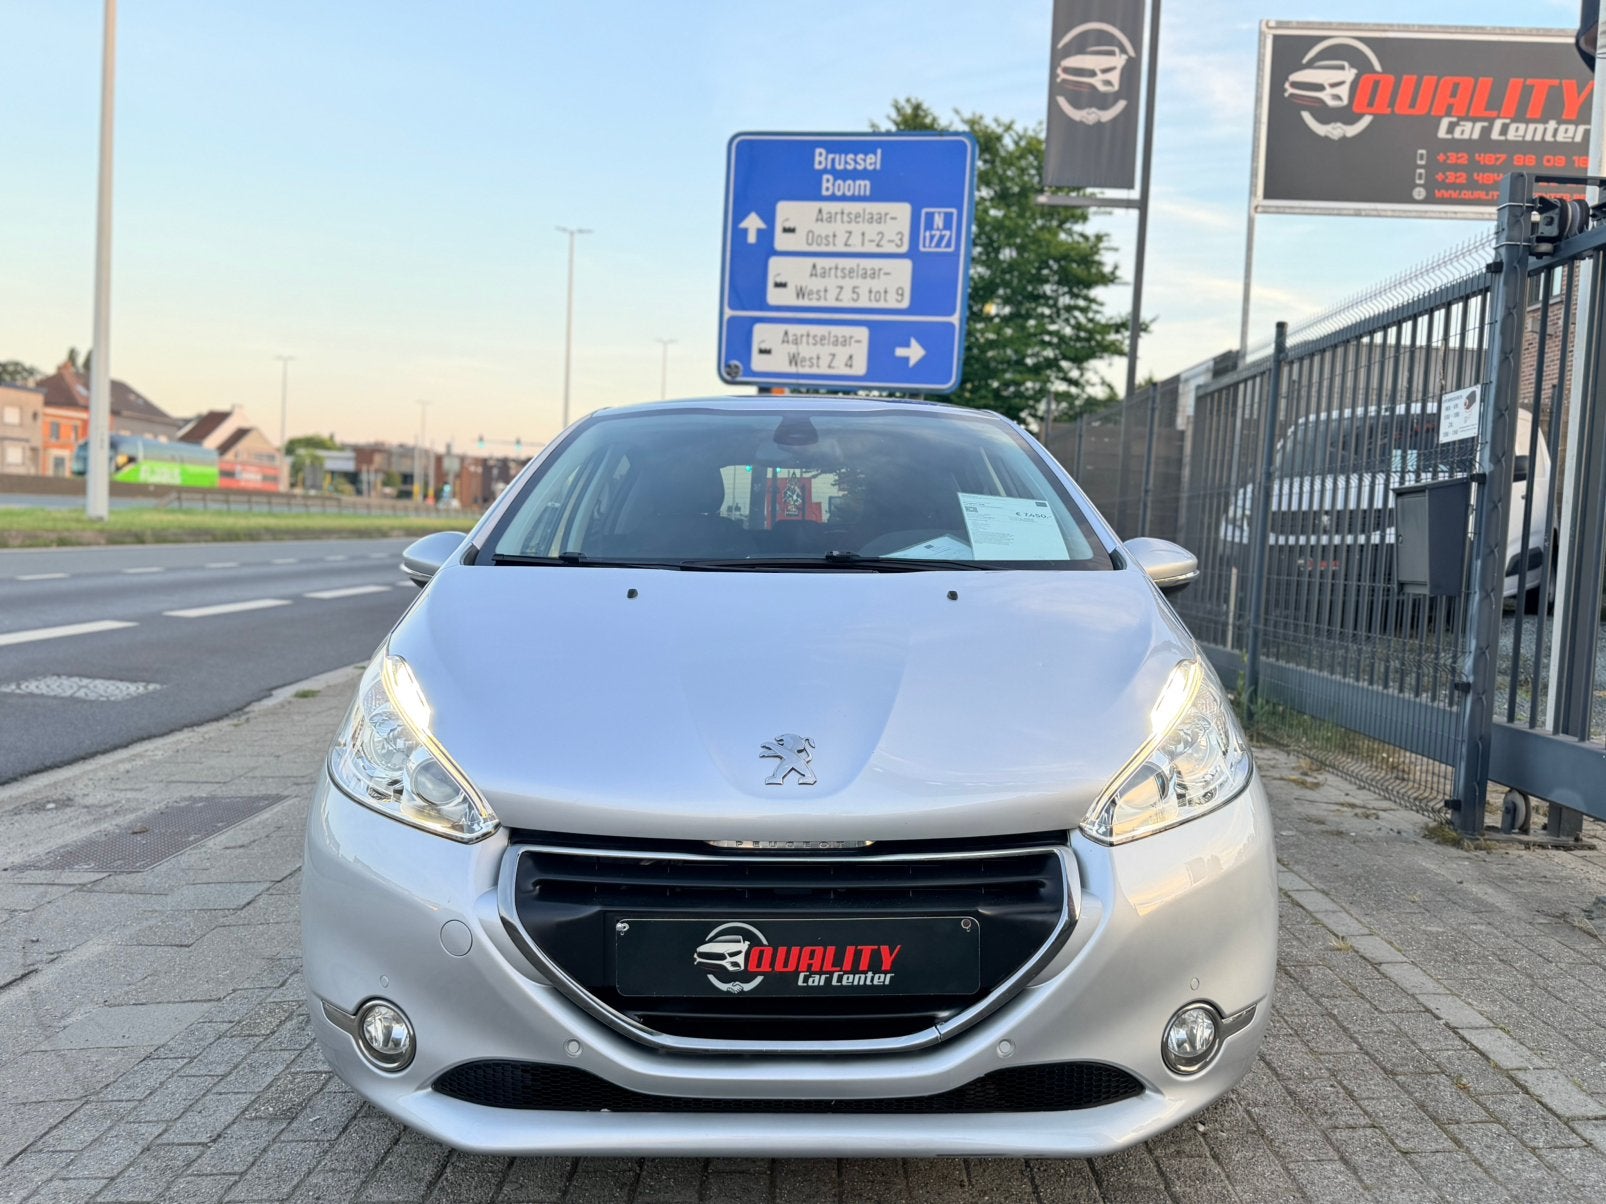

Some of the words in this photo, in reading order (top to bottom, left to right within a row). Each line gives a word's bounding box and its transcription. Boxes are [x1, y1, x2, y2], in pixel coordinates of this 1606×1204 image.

[1352, 73, 1595, 119] QUALITY
[1437, 117, 1488, 140] Car
[1491, 119, 1591, 142] Center
[814, 148, 882, 170] Brussel
[1436, 152, 1468, 165] +32
[821, 174, 871, 197] Boom
[1435, 171, 1467, 184] +32
[815, 208, 898, 226] Aartselaar-
[933, 212, 944, 229] N
[805, 230, 837, 247] Oost
[924, 232, 950, 249] 177
[809, 263, 892, 280] Aartselaar-
[795, 285, 828, 301] West
[868, 287, 888, 303] tot
[895, 286, 905, 303] 9
[781, 329, 862, 347] Aartselaar-
[787, 352, 821, 369] West
[747, 945, 901, 973] QUALITY
[798, 971, 829, 986] Car
[832, 971, 895, 986] Center
